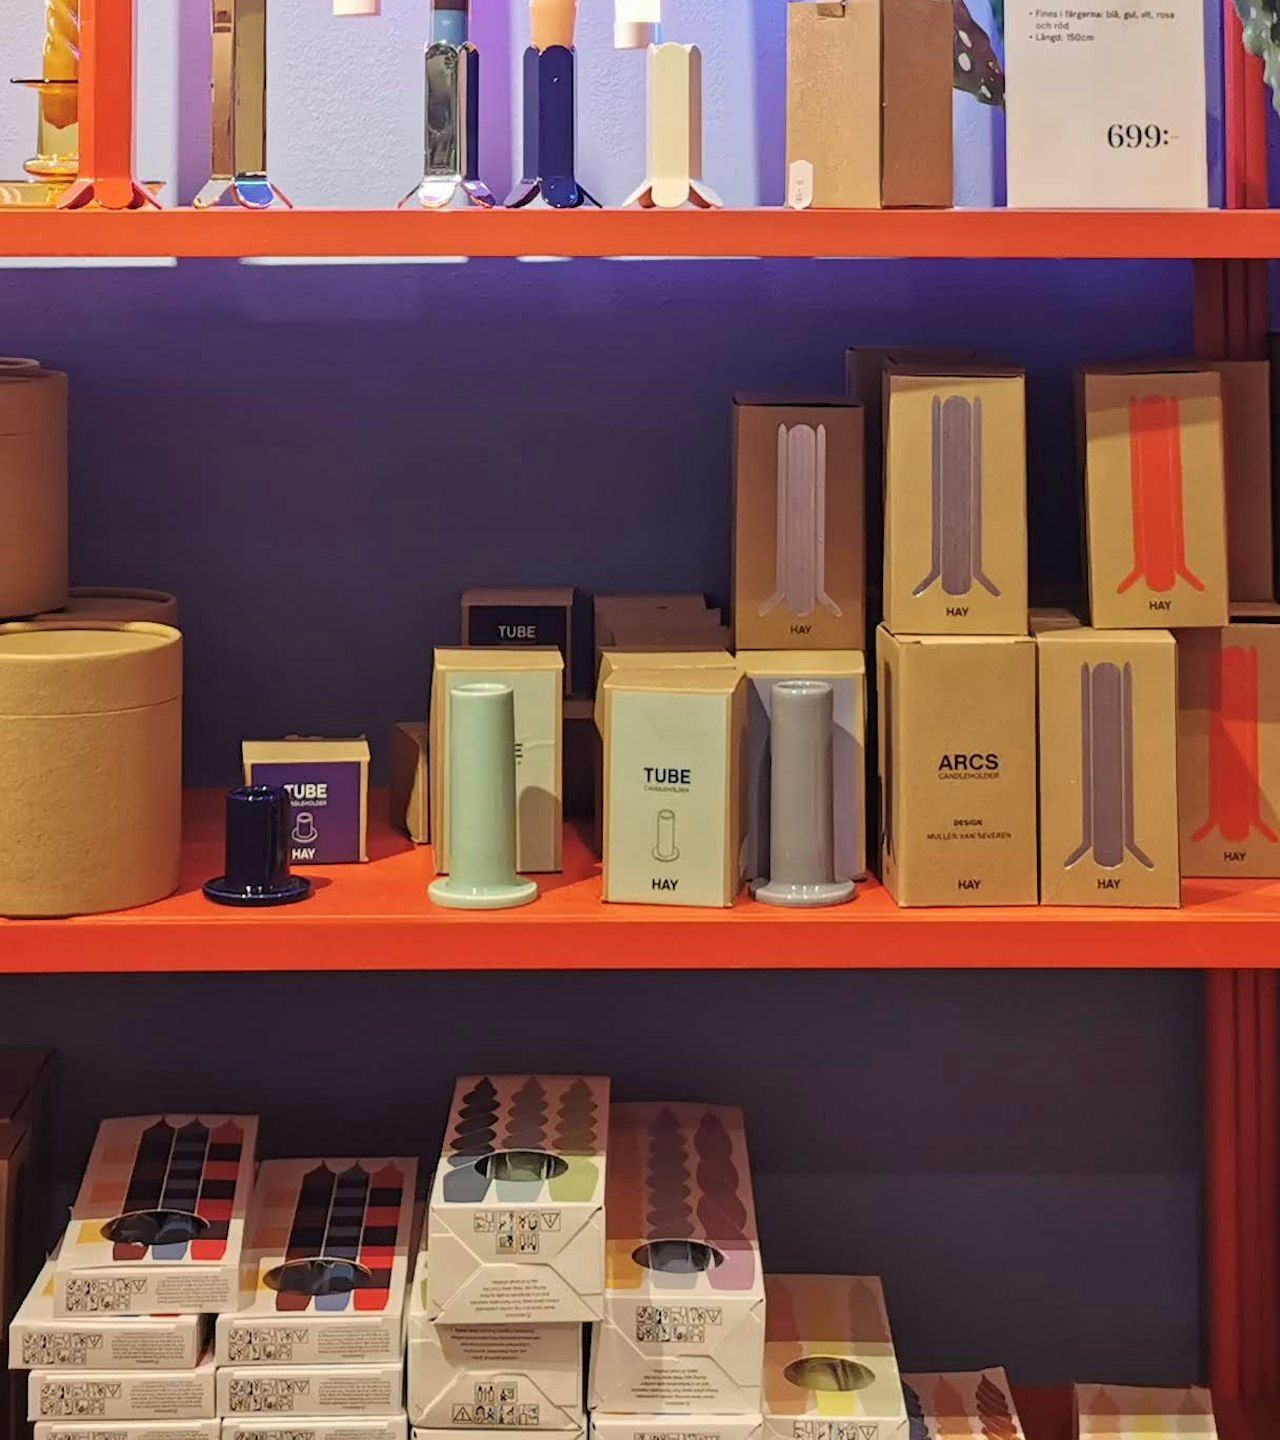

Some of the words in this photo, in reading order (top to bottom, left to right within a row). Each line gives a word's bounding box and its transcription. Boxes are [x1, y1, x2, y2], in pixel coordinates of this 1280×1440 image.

[1149, 600, 1171, 611] HAY
[946, 607, 969, 617] HAY
[497, 625, 537, 638] TUBE
[790, 624, 812, 634] HAY
[938, 753, 999, 771] ARCS
[643, 767, 692, 784] TUBE
[938, 772, 1000, 780] CANDLEHOLDER
[283, 783, 328, 799] TUBE
[953, 818, 983, 827] DESIGN
[291, 848, 316, 860] HAY
[1223, 851, 1246, 861] HAY
[651, 878, 679, 891] HAY
[958, 879, 981, 890] HAY
[1097, 879, 1121, 890] HAY
